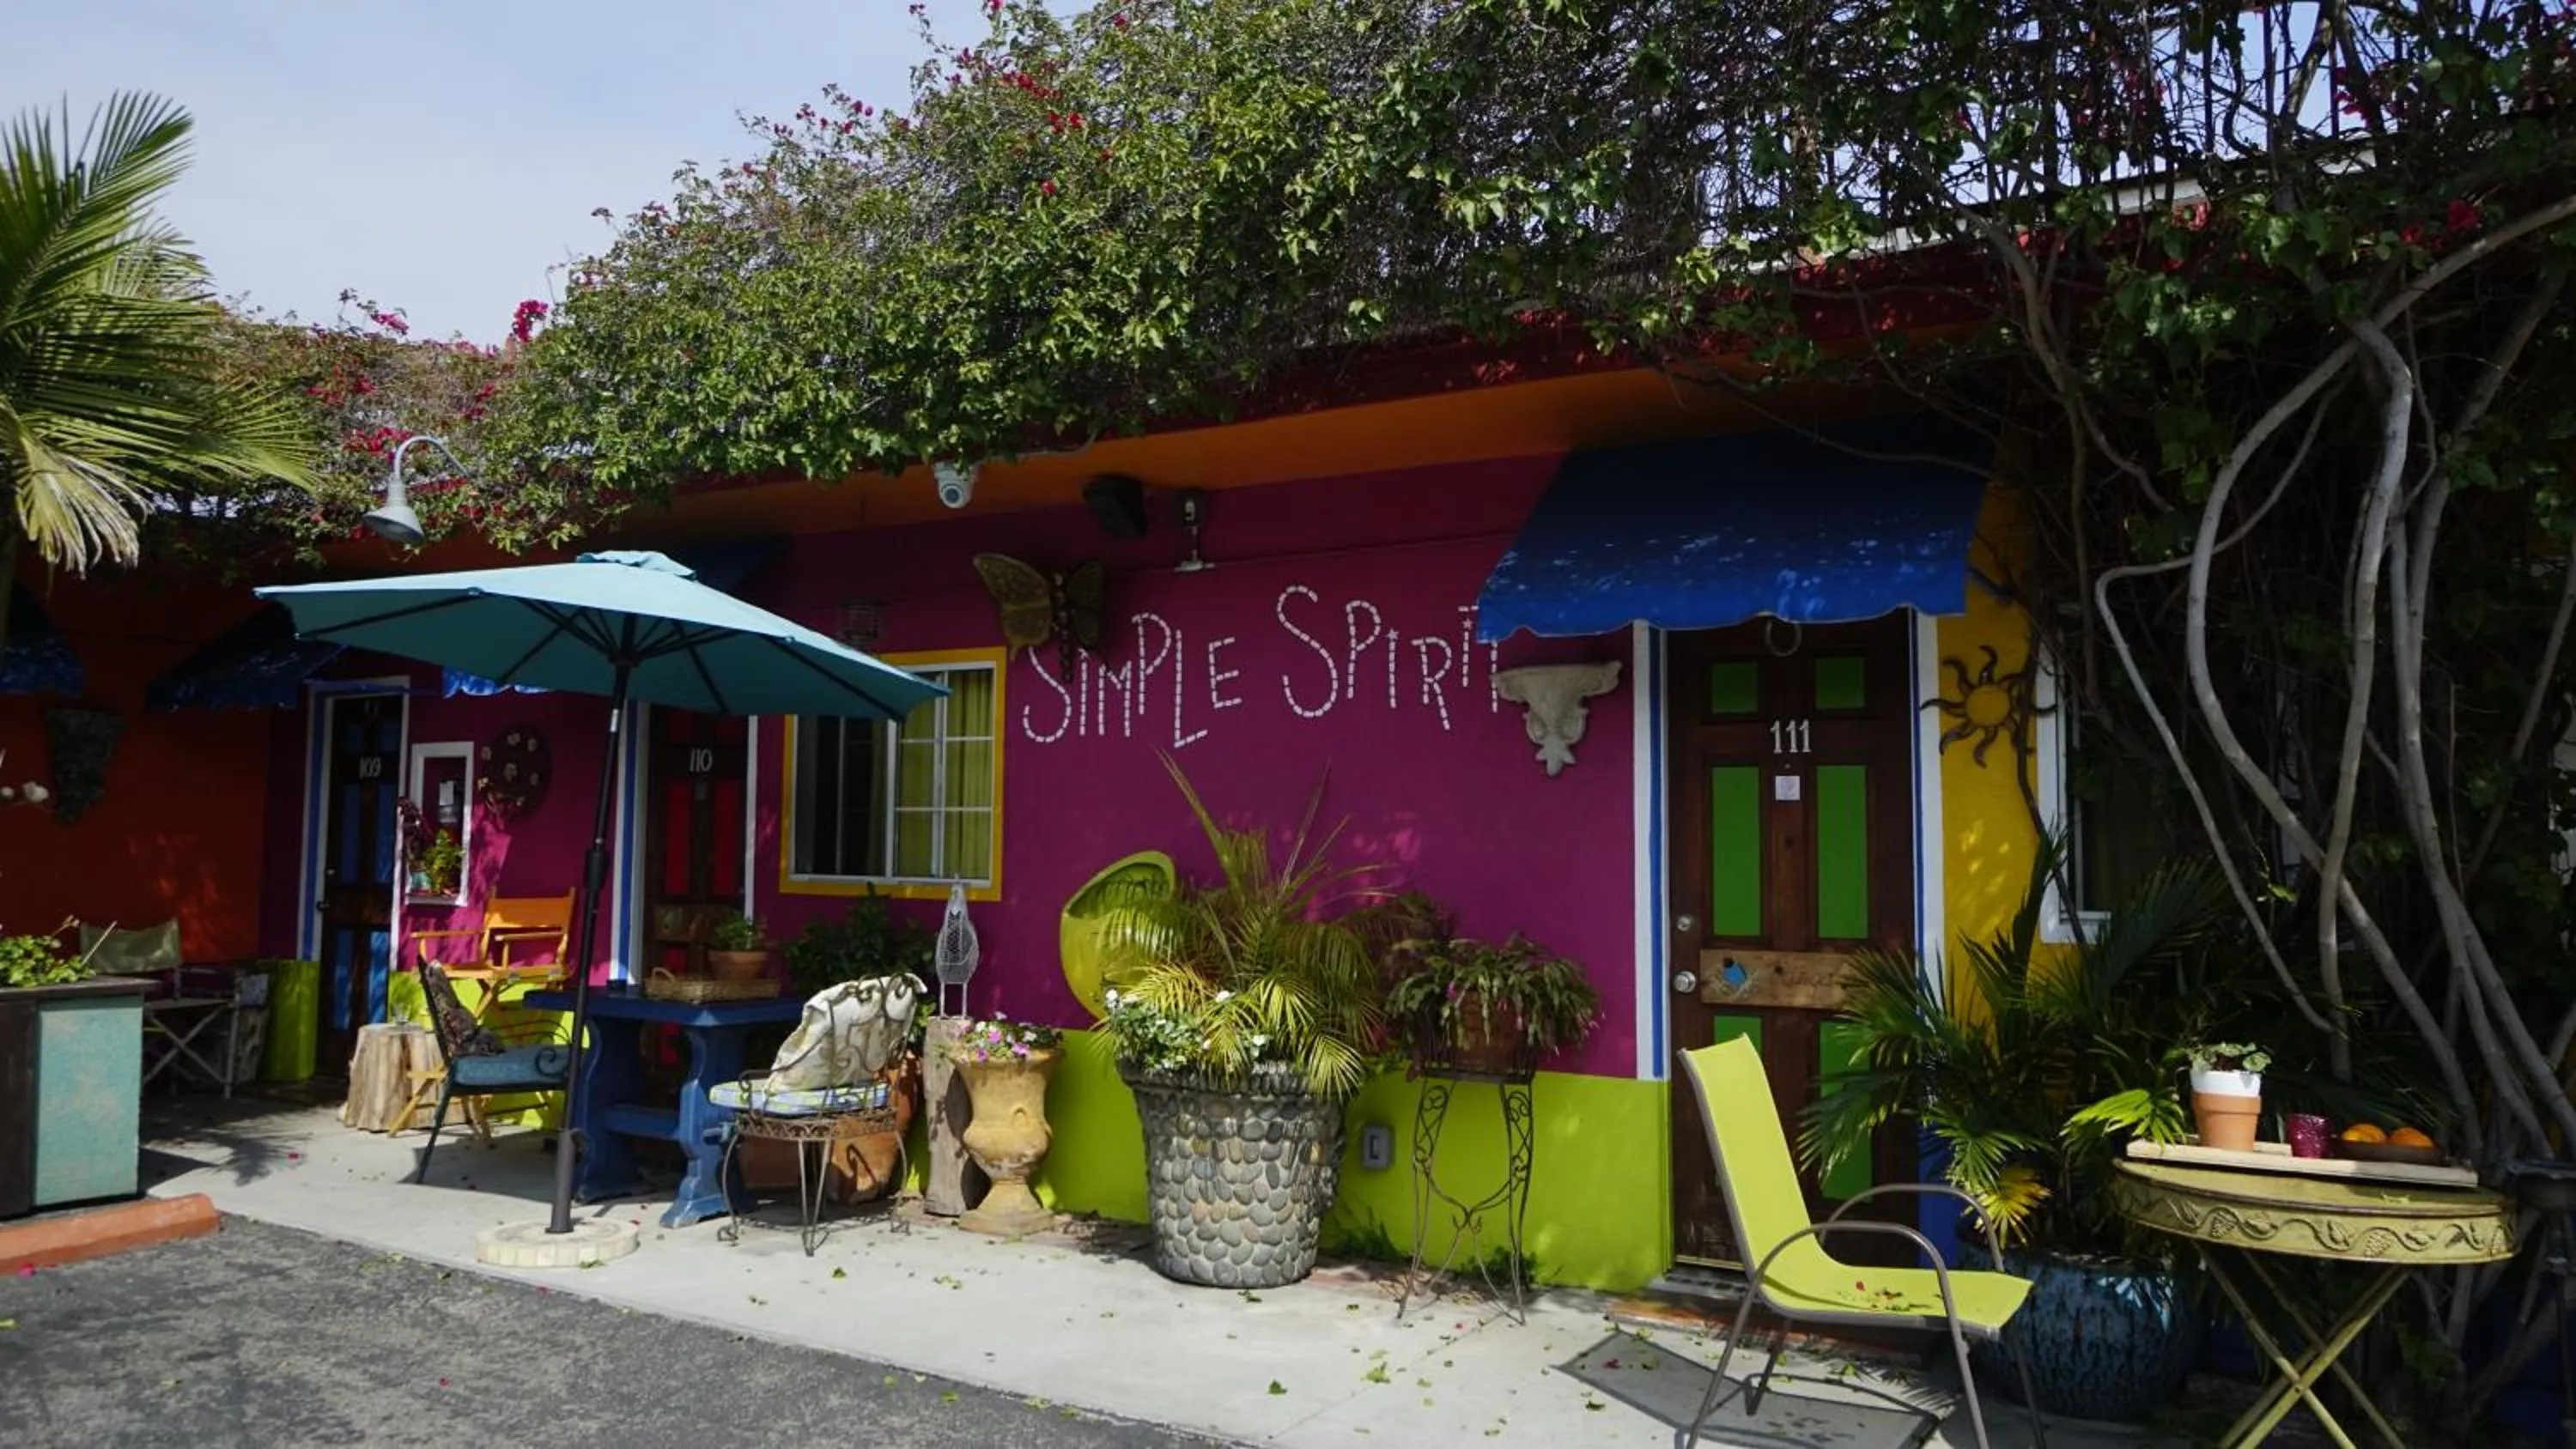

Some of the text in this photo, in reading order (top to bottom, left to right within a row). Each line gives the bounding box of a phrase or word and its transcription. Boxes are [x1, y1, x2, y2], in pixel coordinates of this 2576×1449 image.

[1770, 719, 1812, 754] 111
[359, 756, 382, 779] 109
[690, 748, 714, 773] 110
